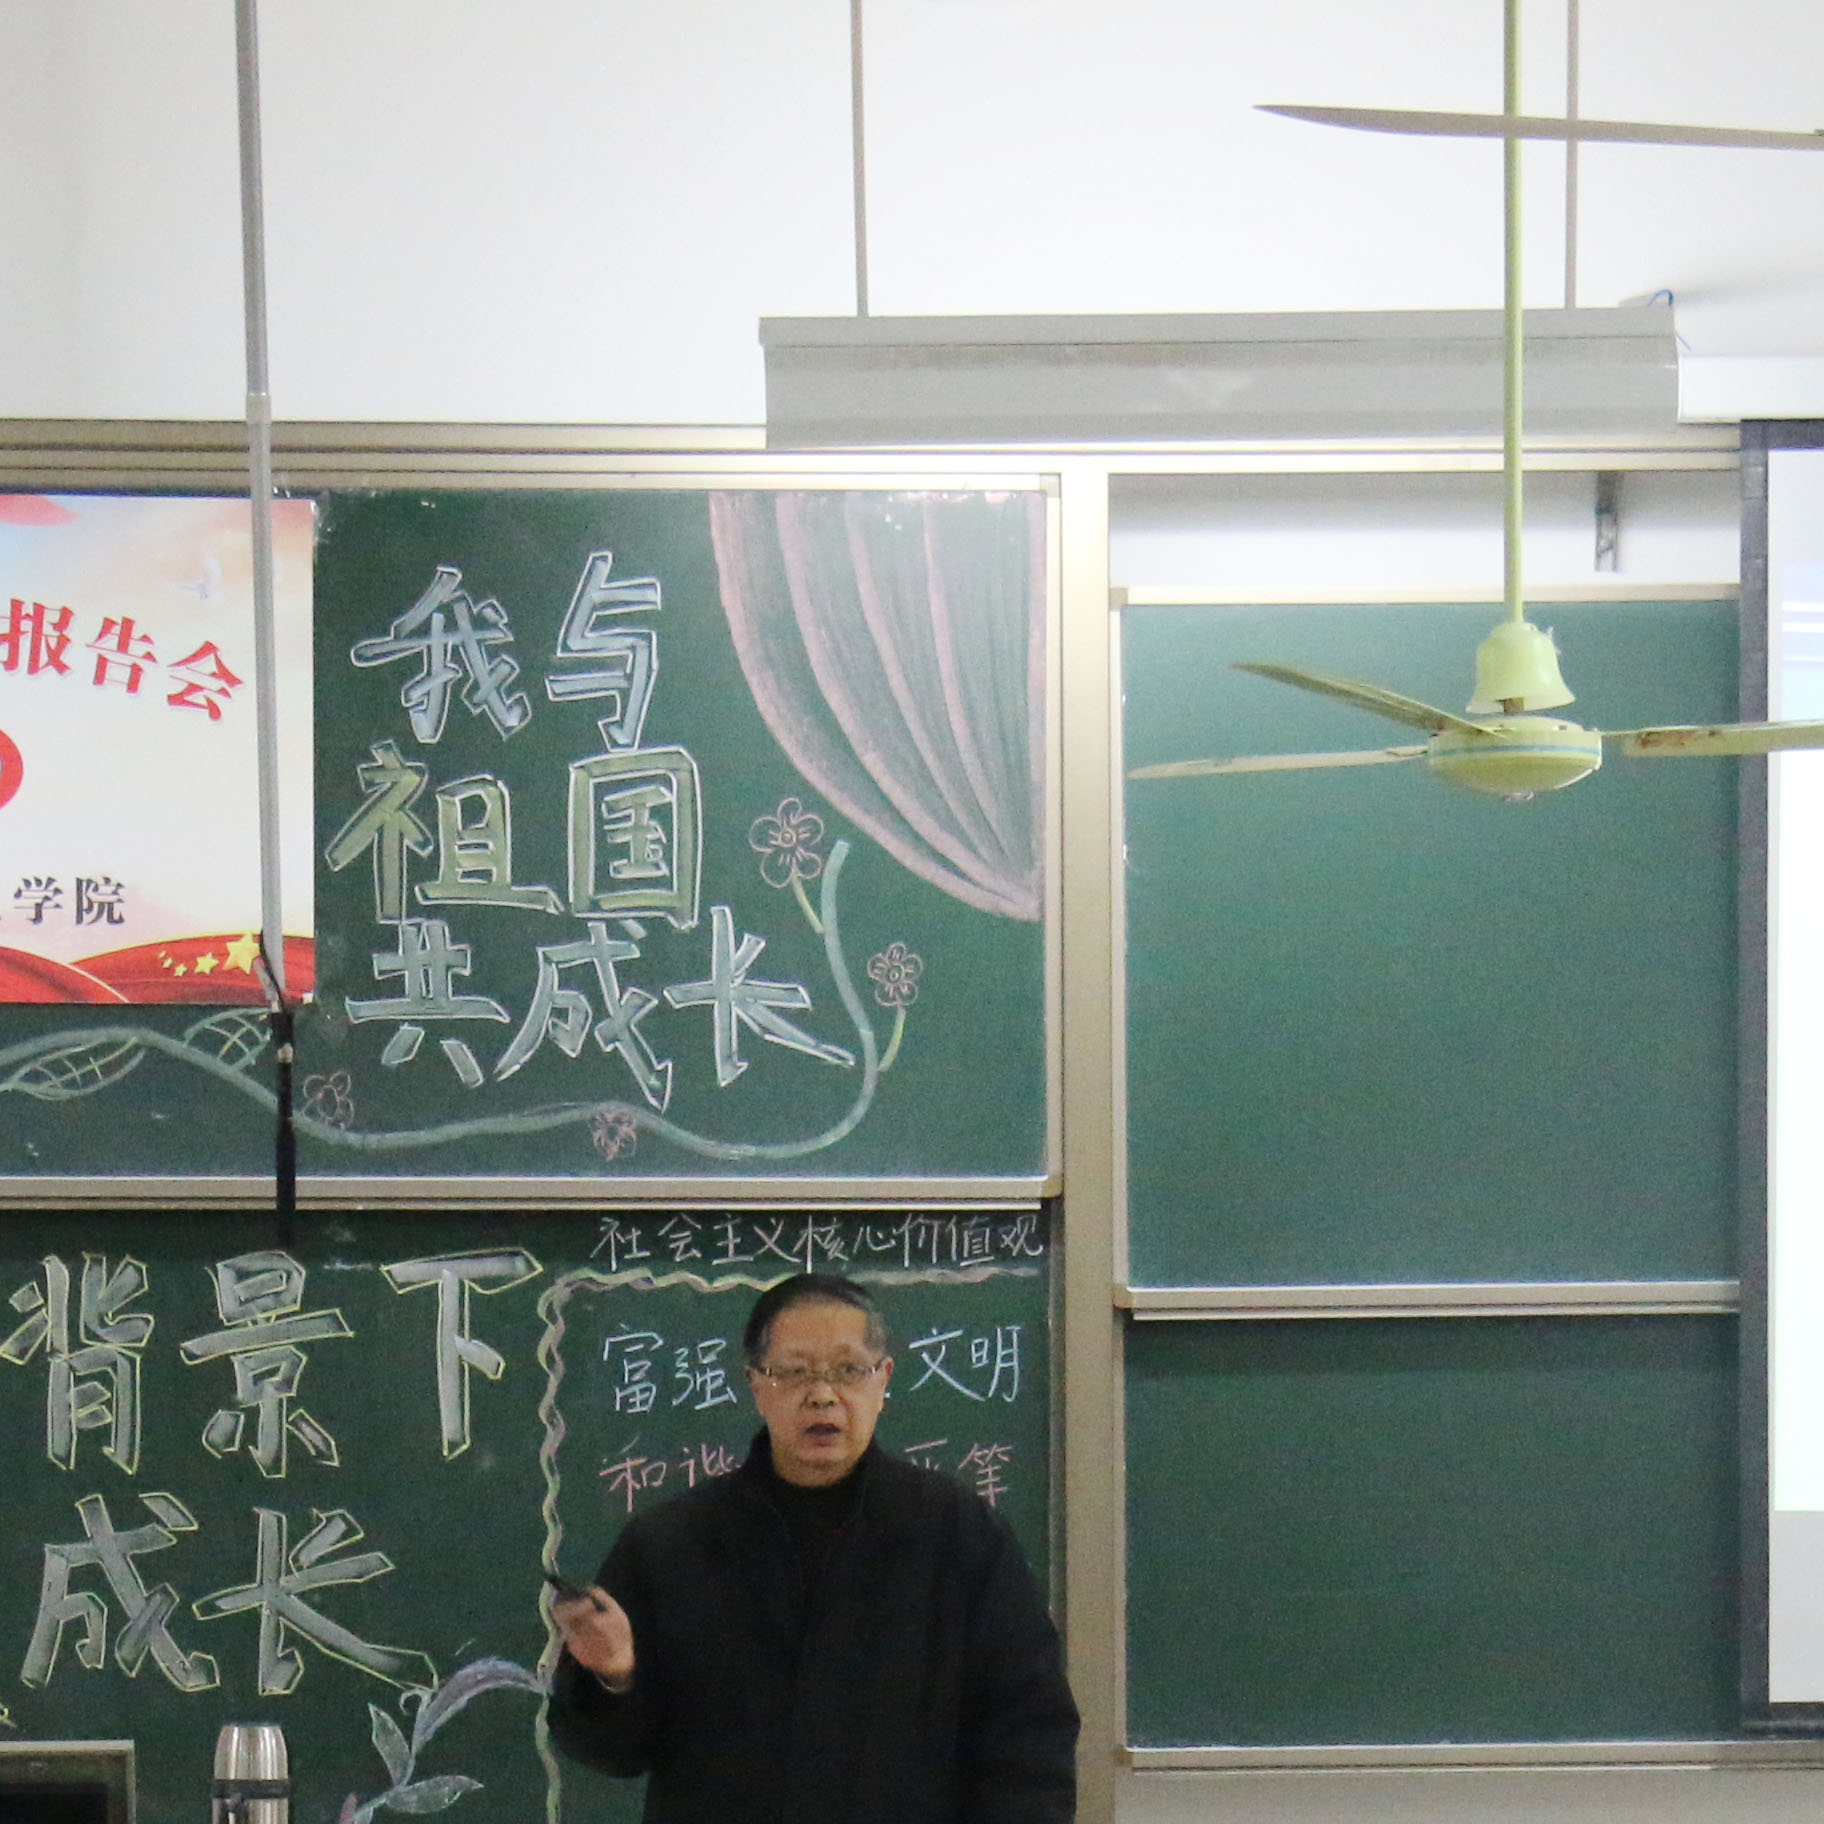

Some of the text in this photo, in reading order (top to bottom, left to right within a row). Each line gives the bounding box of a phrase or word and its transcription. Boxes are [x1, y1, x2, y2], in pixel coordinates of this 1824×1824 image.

[350, 550, 662, 750] 我与
[325, 741, 703, 929] 祖国
[344, 905, 855, 1112] 共成长
[590, 1213, 1043, 1273] 社会主义核心价值观
[602, 1324, 1023, 1414] 富强 文明
